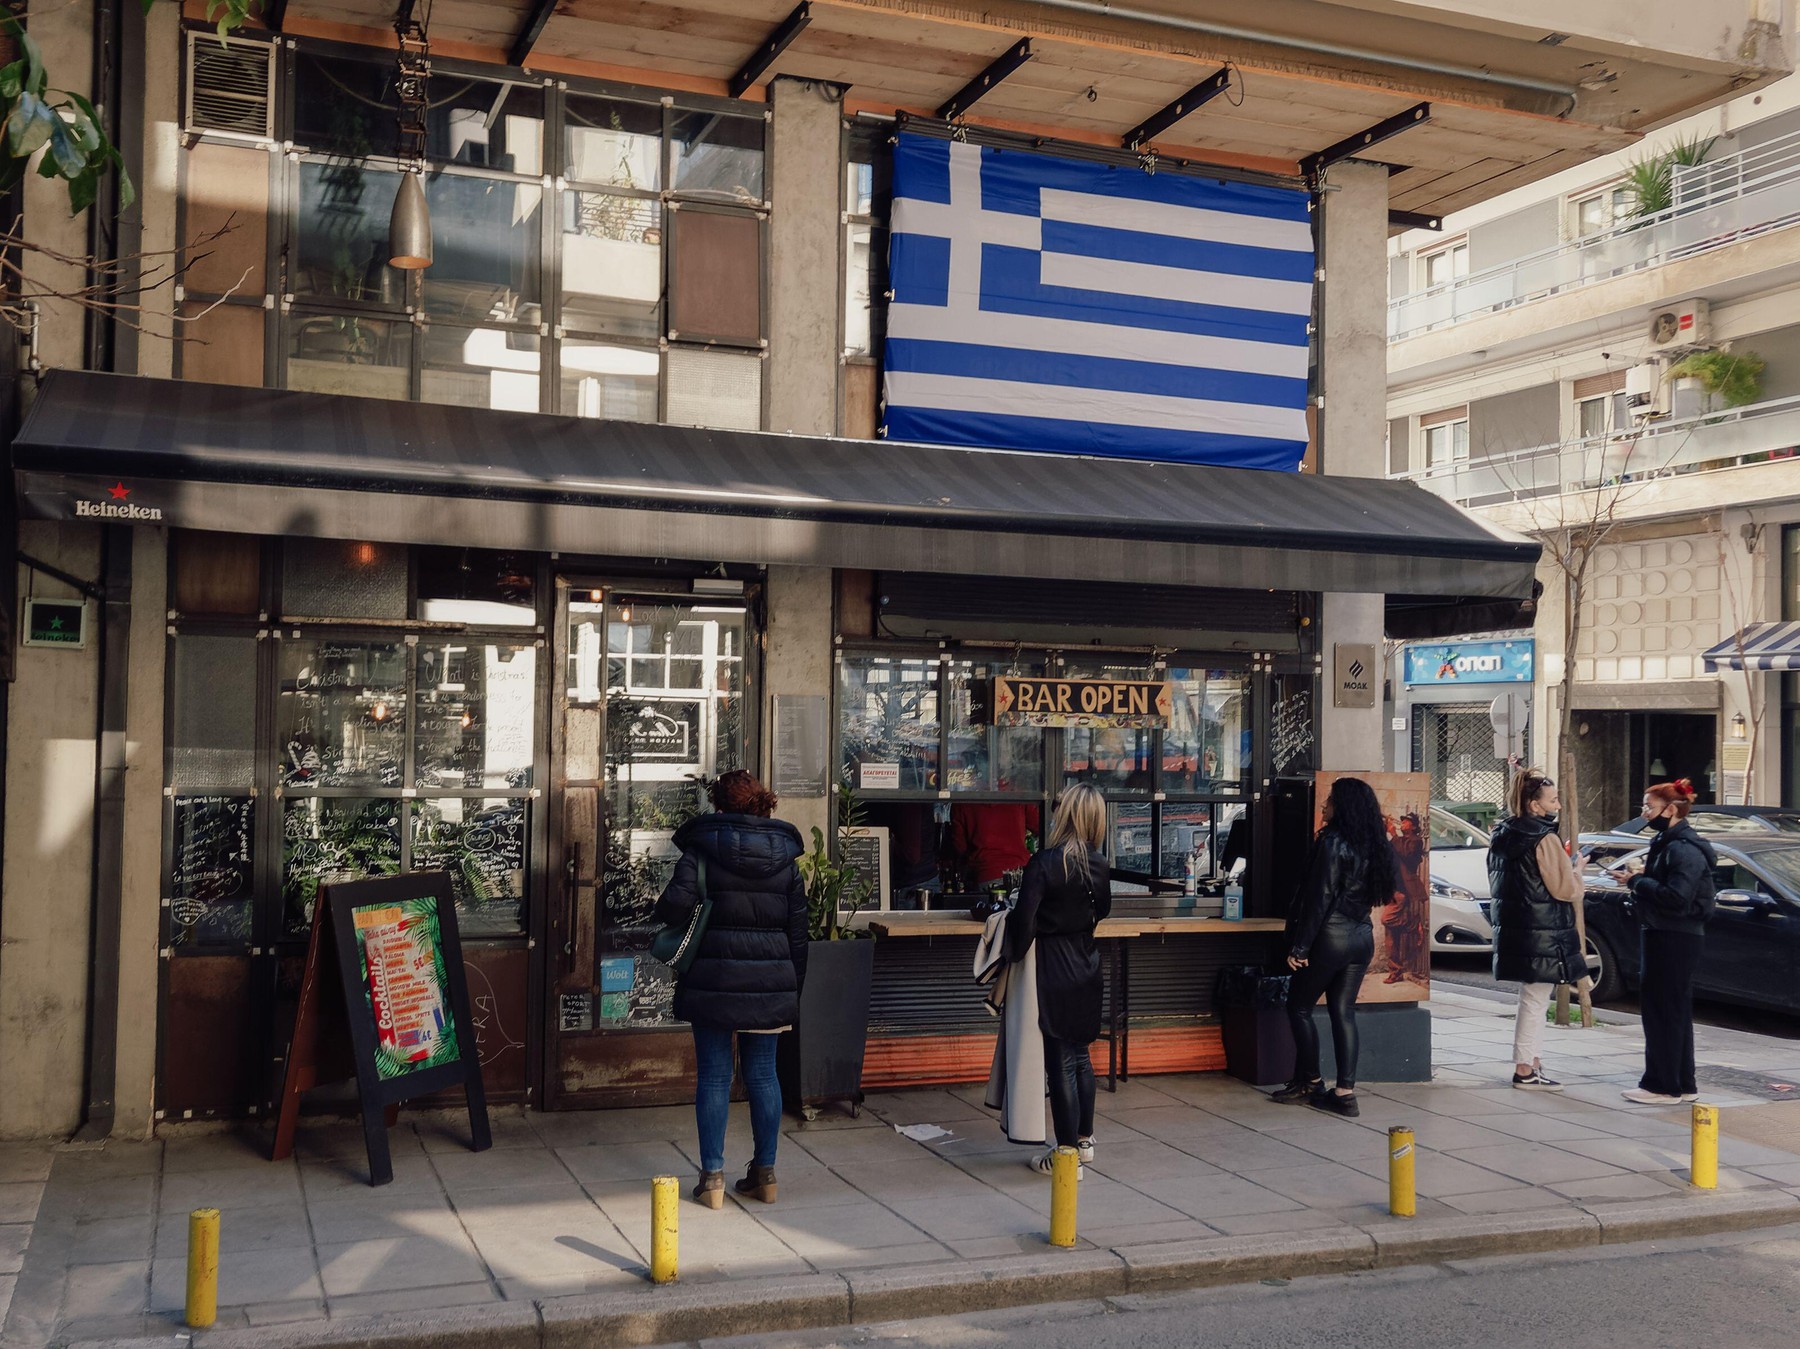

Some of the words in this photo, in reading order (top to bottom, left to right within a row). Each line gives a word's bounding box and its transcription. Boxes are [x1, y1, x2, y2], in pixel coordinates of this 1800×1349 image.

[76, 500, 162, 520] Heineken
[1344, 682, 1368, 690] MOAK
[1018, 684, 1073, 712] BAR
[1081, 685, 1149, 714] OPEN
[606, 970, 630, 980] Wolt
